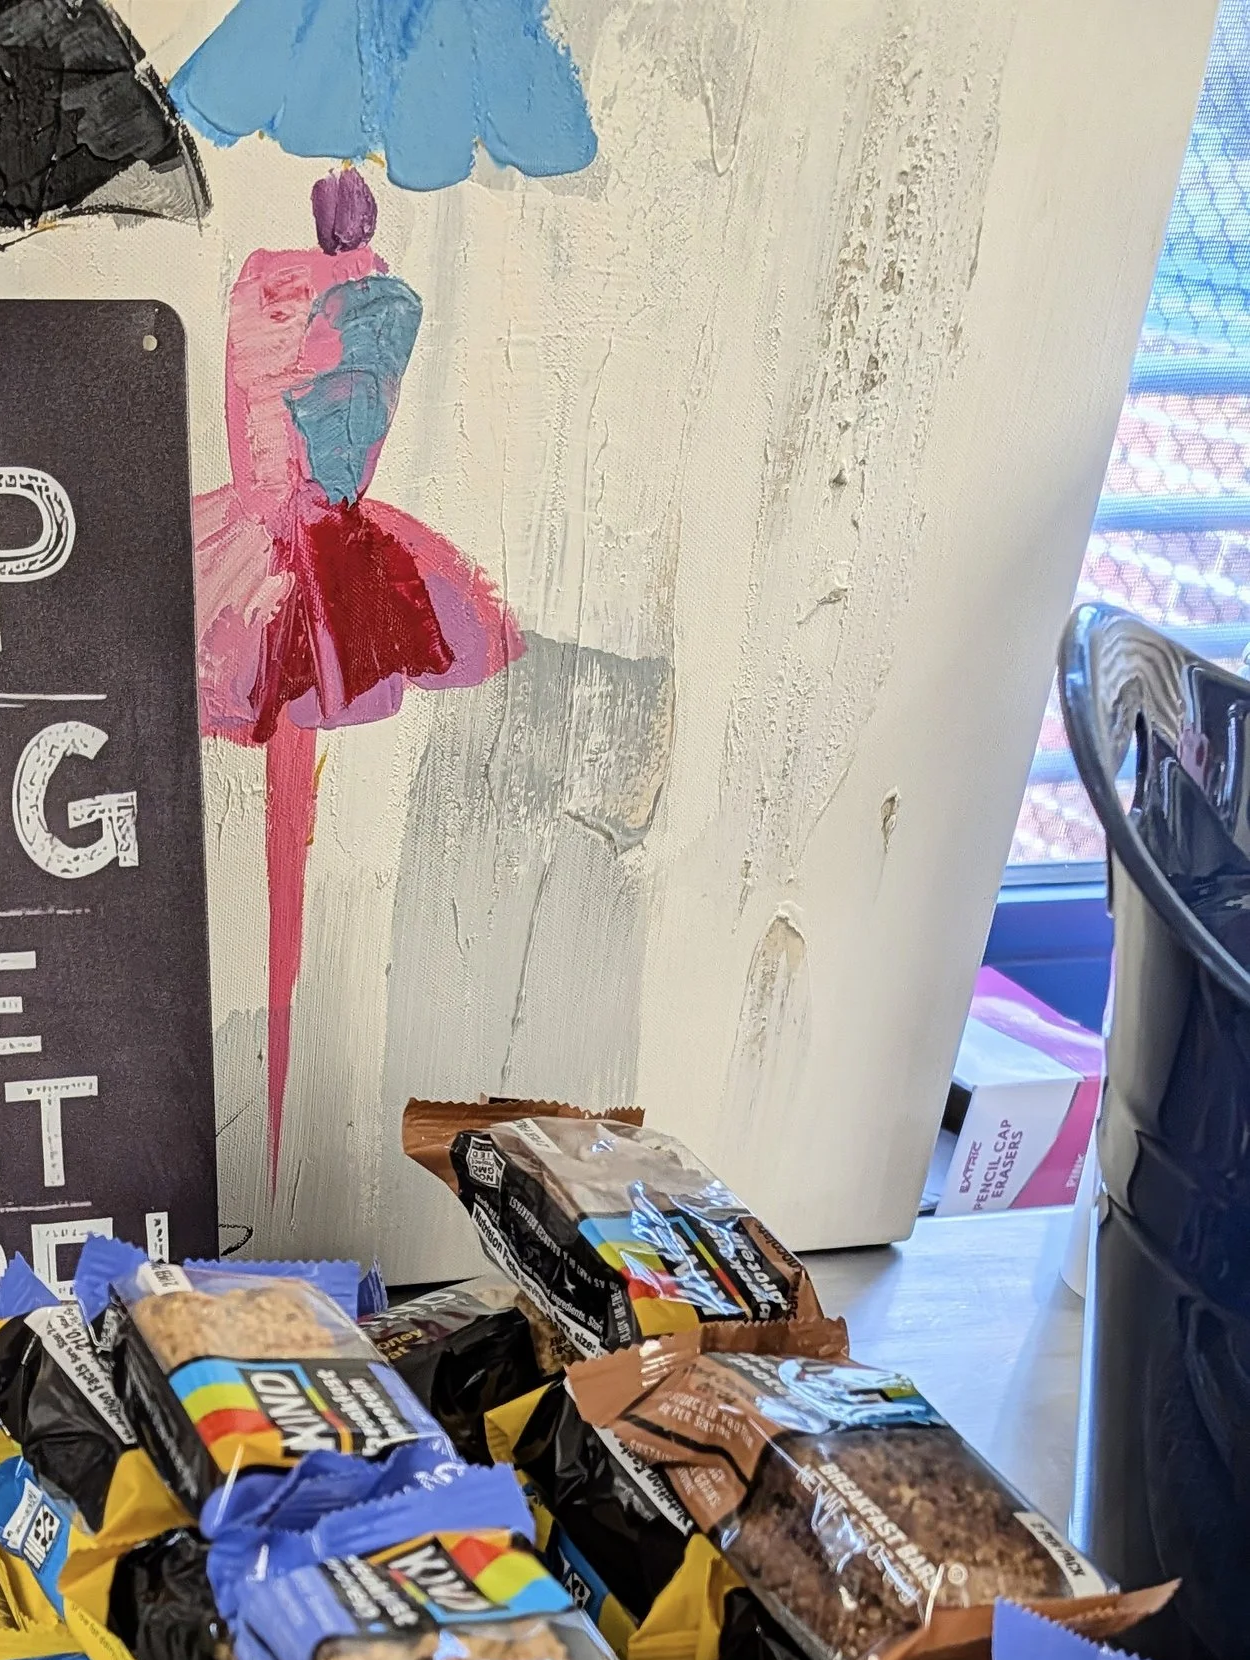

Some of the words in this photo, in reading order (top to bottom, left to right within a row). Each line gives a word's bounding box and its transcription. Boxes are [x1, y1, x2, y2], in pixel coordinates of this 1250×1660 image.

[972, 1155, 1001, 1211] PENCIL
[993, 1119, 1012, 1154] CAP
[991, 1130, 1023, 1198] ERASERS
[473, 1207, 504, 1251] Nutrition
[502, 1247, 521, 1280] Facts
[376, 1328, 423, 1350] oney
[249, 1370, 338, 1452] KIND
[348, 1377, 408, 1439] protein
[818, 1461, 908, 1550] BREAKFAST
